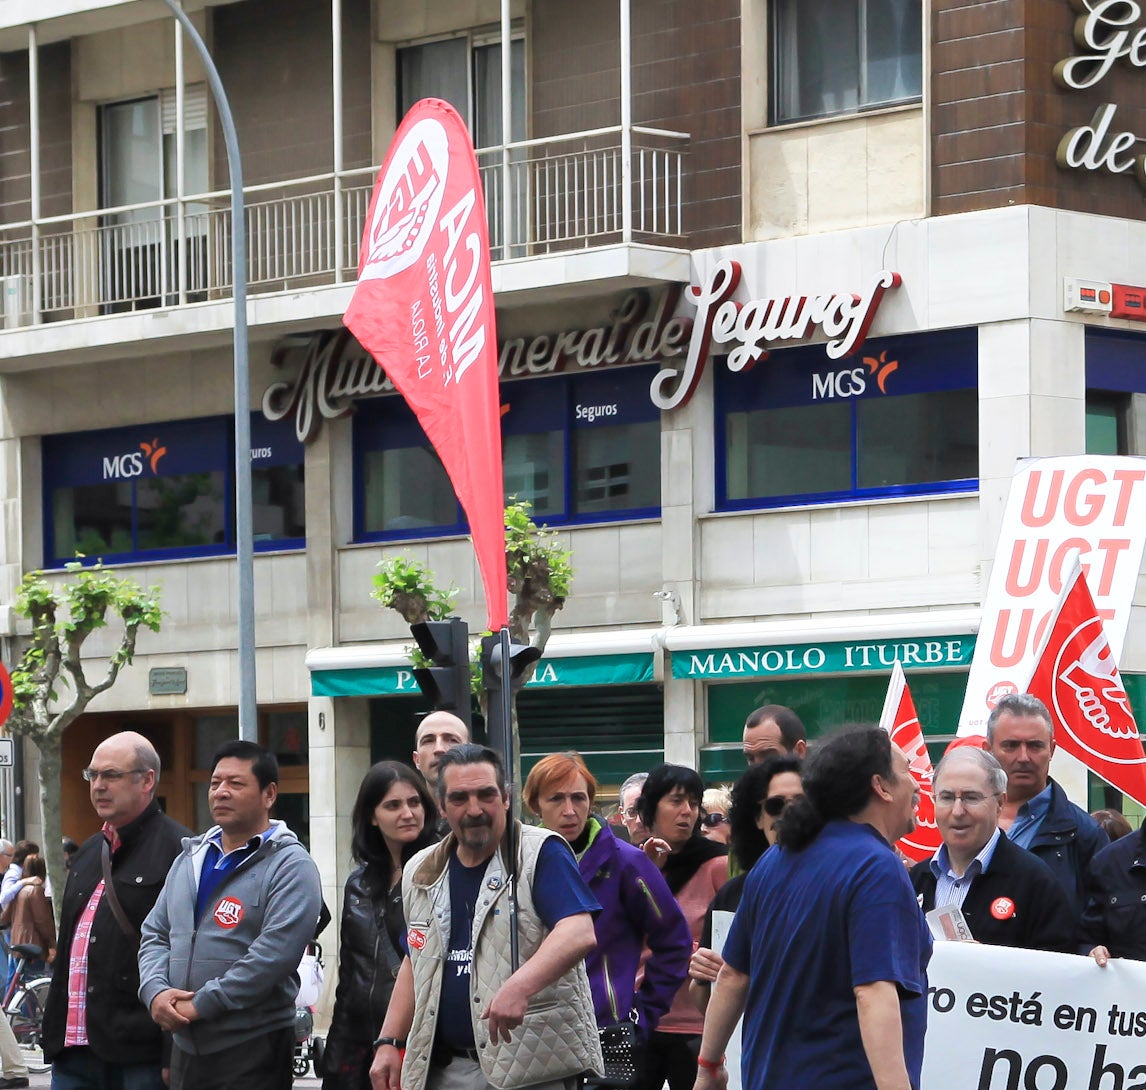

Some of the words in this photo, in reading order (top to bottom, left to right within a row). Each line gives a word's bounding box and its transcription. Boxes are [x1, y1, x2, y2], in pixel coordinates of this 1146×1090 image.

[1065, 103, 1136, 172] de
[498, 294, 643, 374] neral
[626, 286, 683, 362] de
[651, 258, 893, 410] Seguros
[812, 368, 866, 399] MGS
[576, 404, 617, 422] Seguros
[102, 452, 143, 479] MGS
[1020, 468, 1146, 528] UGT
[689, 648, 826, 675] MANOLO
[844, 640, 963, 668] ITURBE
[966, 992, 1042, 1026] está
[1053, 1004, 1097, 1033] en
